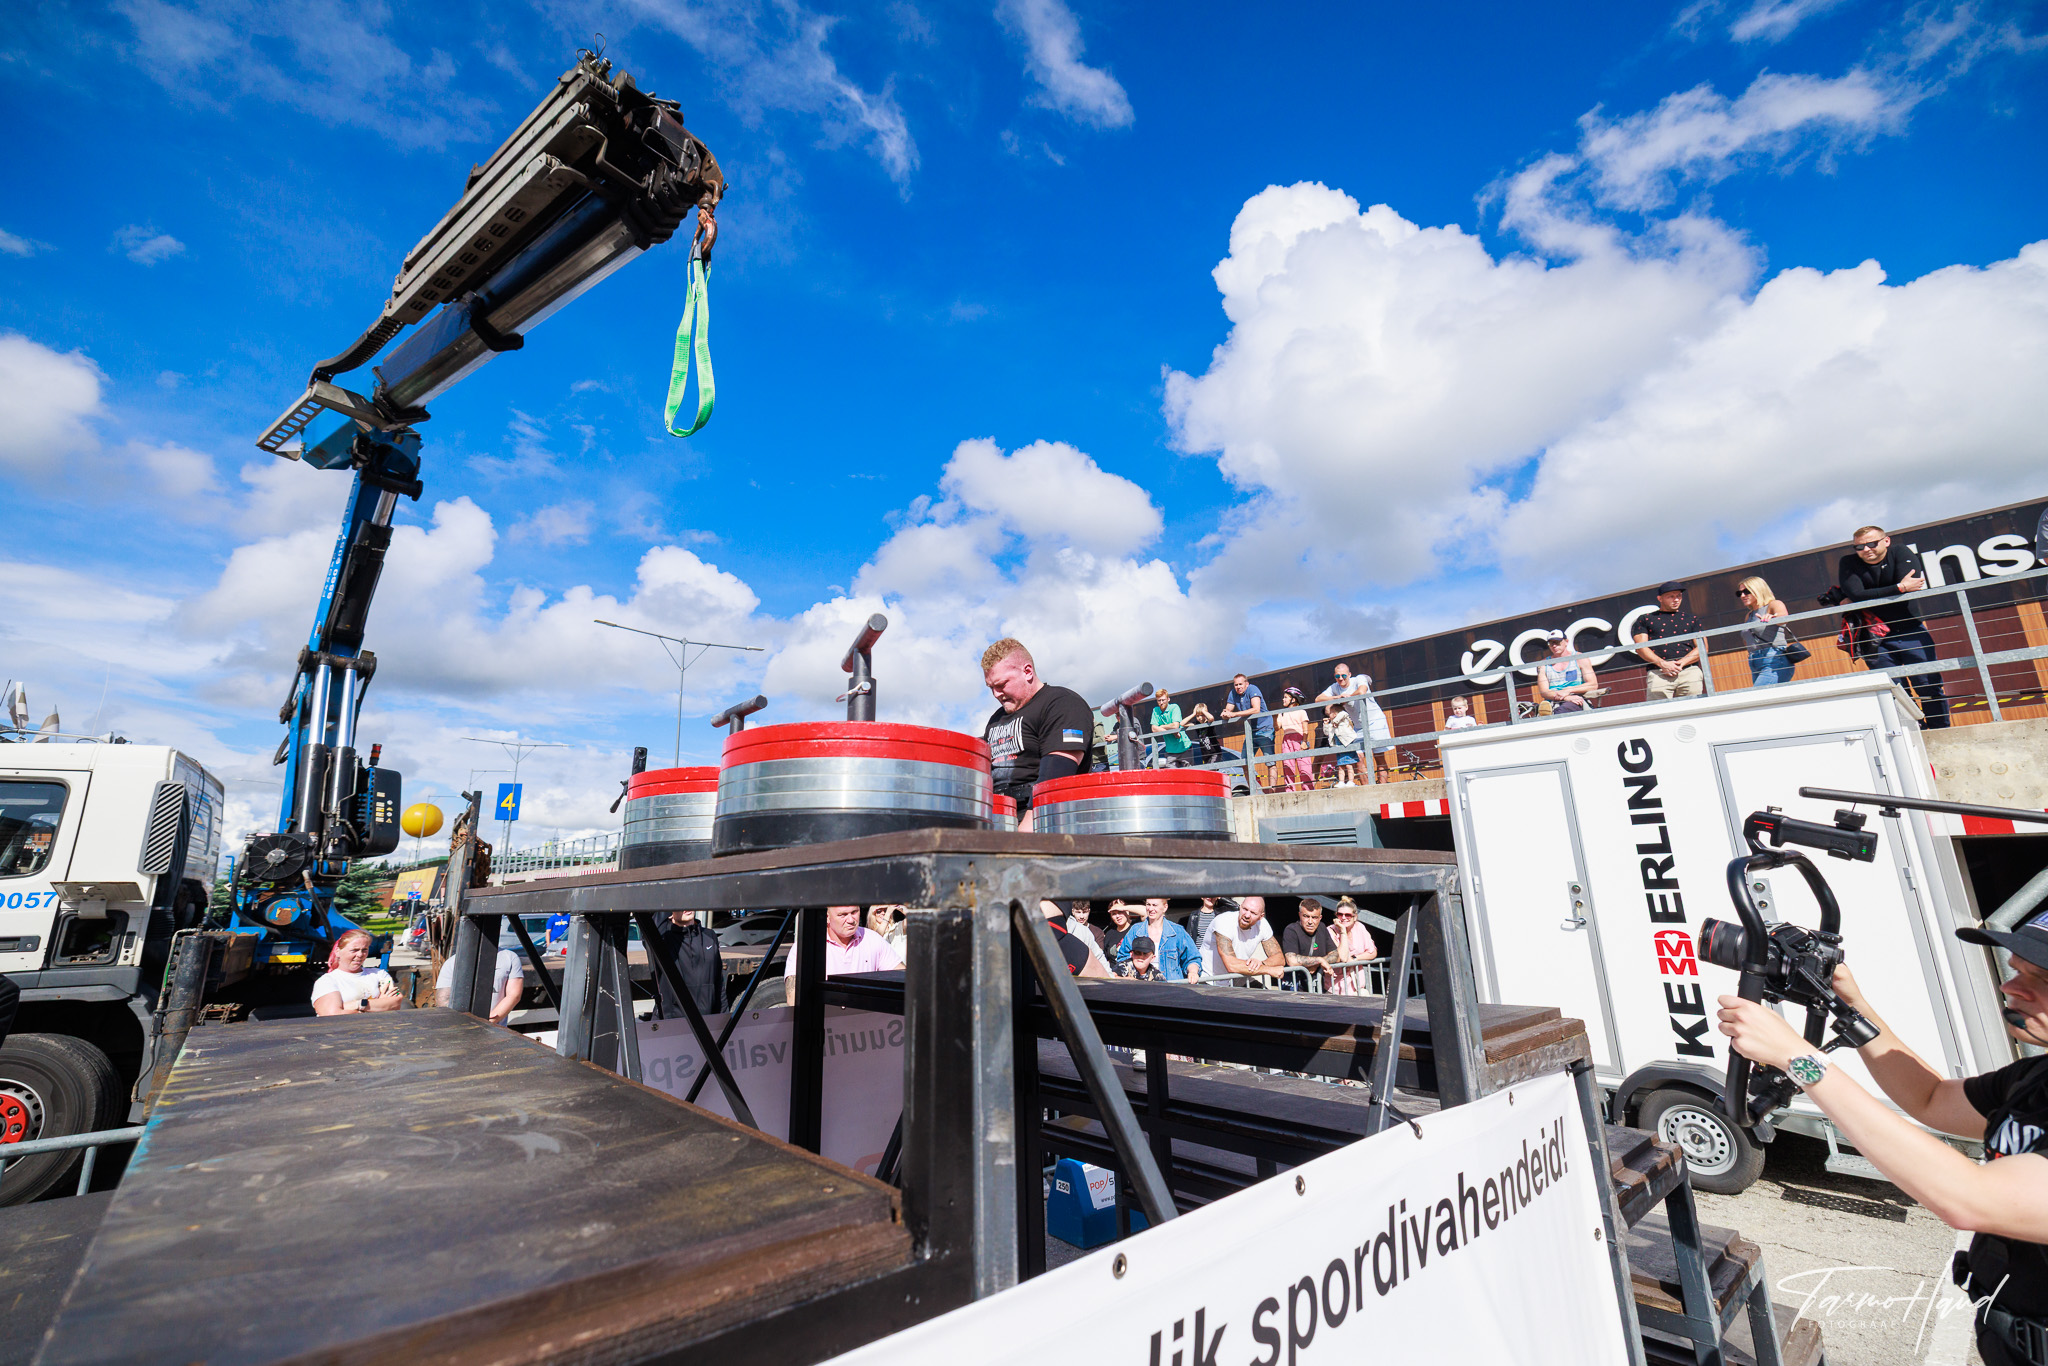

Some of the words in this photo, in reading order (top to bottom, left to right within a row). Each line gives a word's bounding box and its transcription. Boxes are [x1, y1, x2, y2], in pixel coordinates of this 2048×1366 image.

[501, 792, 516, 811] 4
[1058, 1181, 1070, 1192] 250
[1090, 1180, 1105, 1191] POP
[1249, 1115, 1569, 1366] spordivahendeid!
